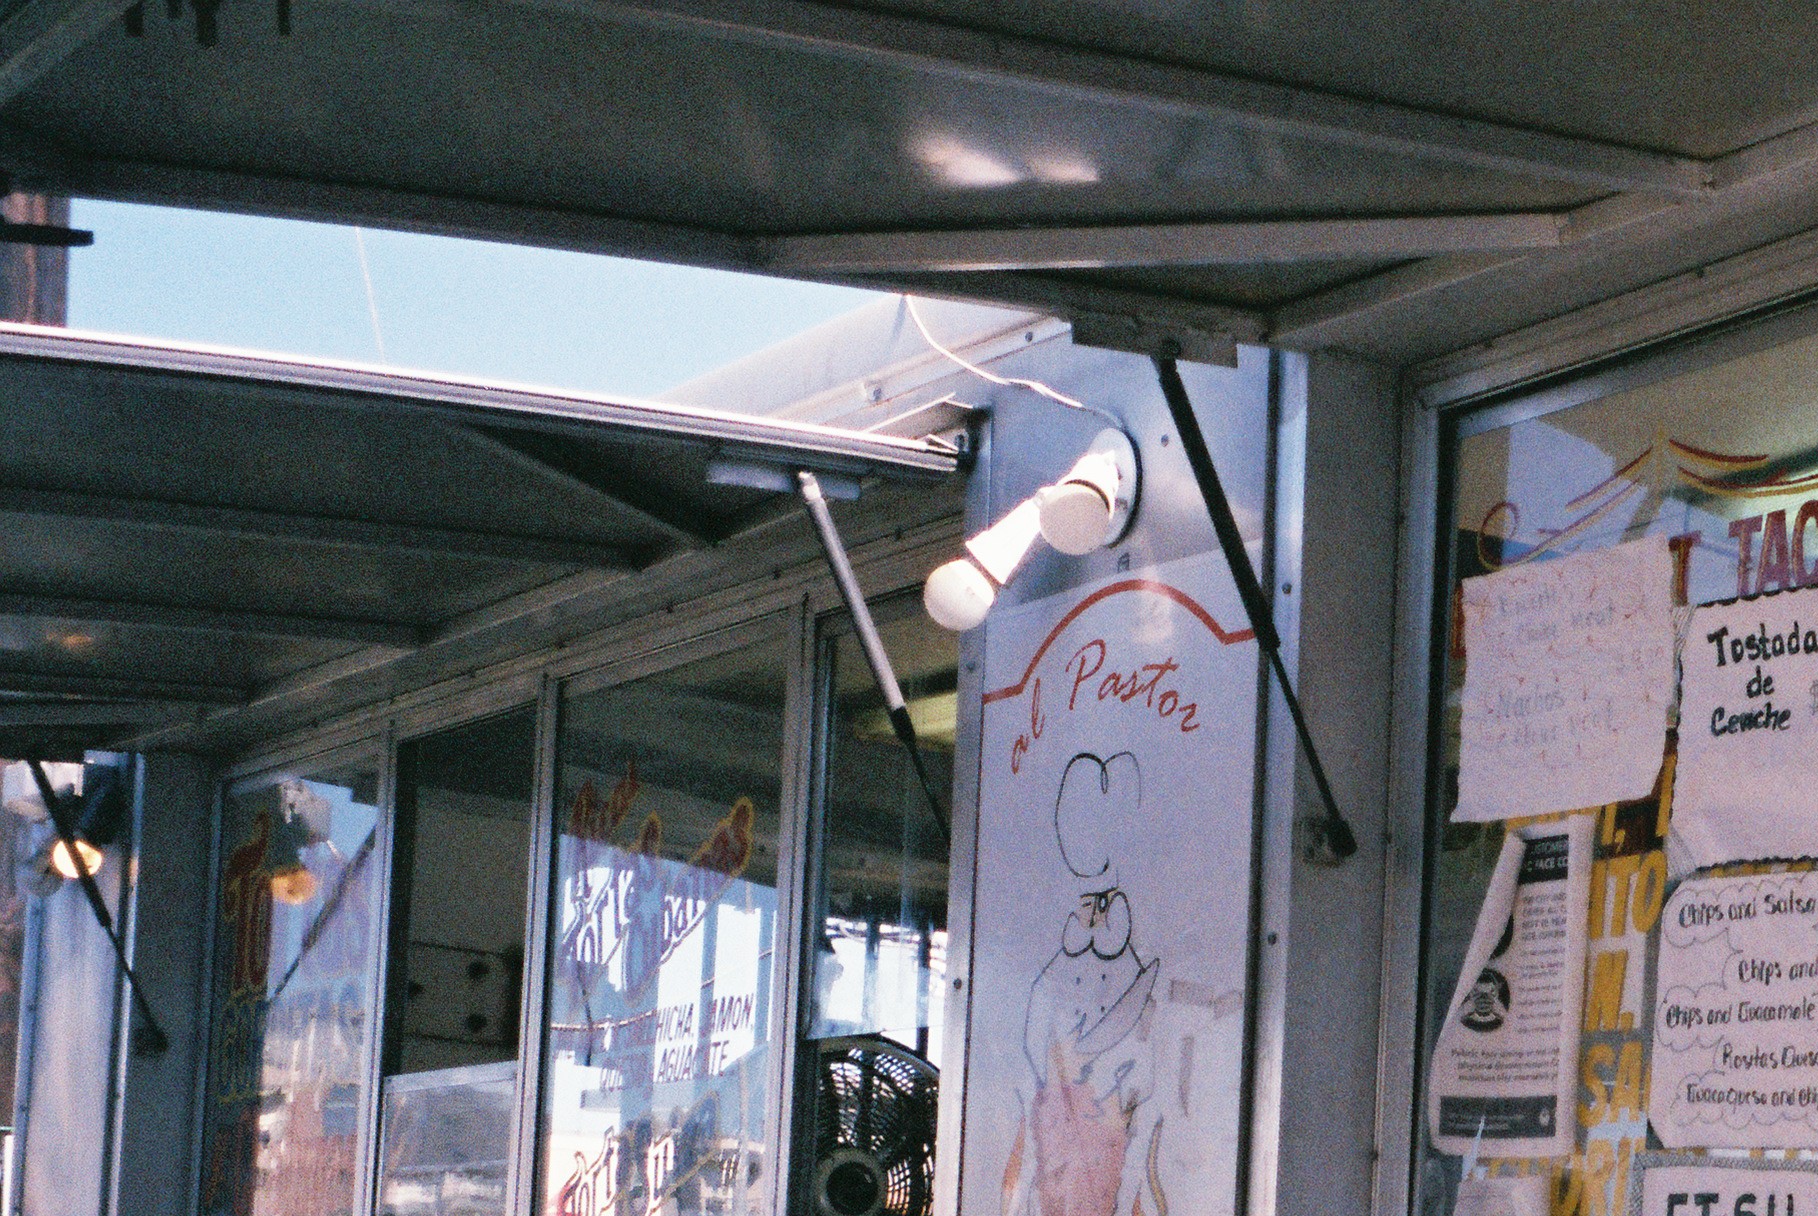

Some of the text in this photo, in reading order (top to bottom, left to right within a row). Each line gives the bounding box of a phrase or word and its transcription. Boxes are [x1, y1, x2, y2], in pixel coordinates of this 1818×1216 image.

[1745, 664, 1777, 699] de
[1677, 888, 1818, 930] Chips and Salsa
[1737, 957, 1783, 987] Chips
[1788, 955, 1818, 982] and
[1665, 1004, 1704, 1030] Chips
[1706, 1003, 1733, 1026] and
